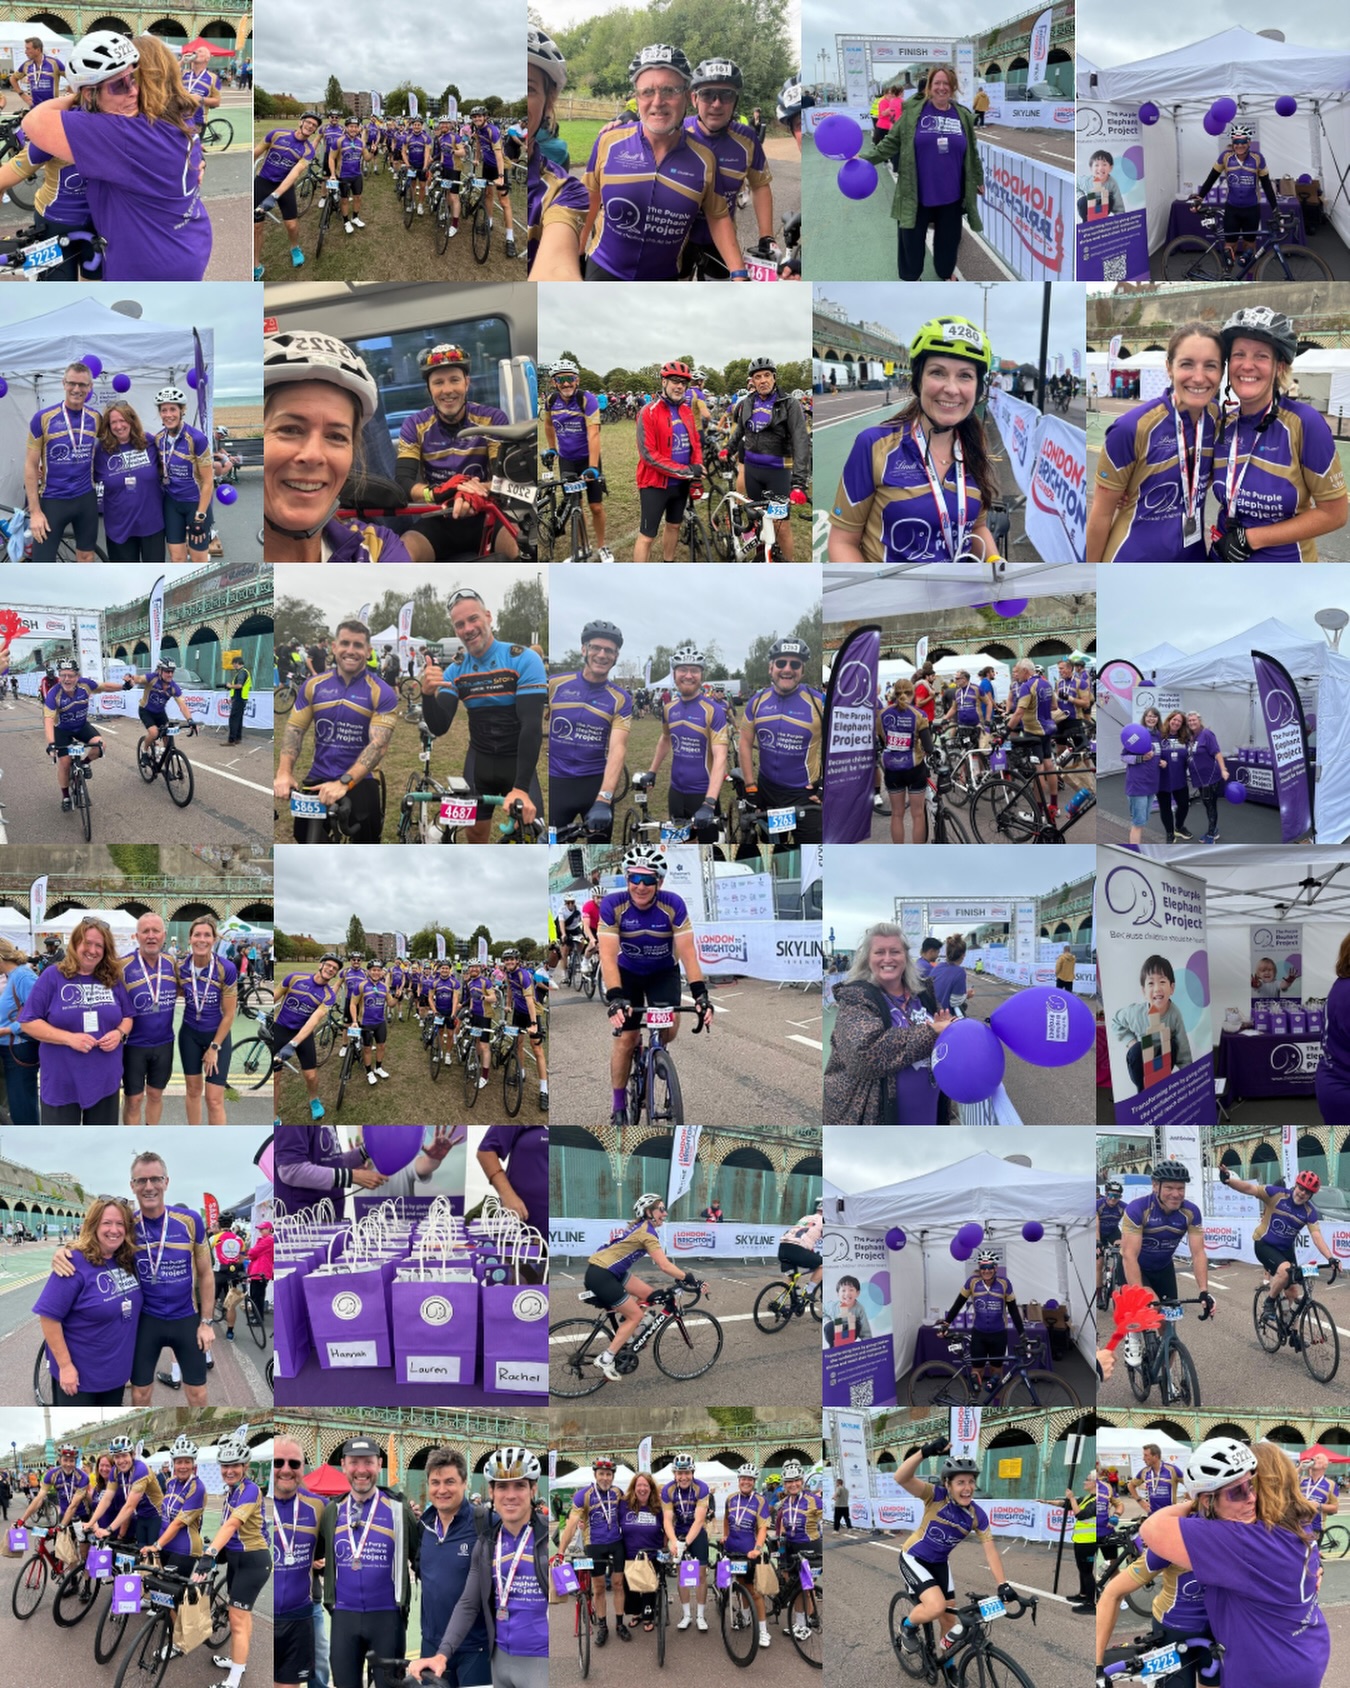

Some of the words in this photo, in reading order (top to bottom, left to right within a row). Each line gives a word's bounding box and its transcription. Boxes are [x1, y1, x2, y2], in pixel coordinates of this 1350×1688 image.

[898, 47, 929, 56] FINISH
[1012, 109, 1041, 118] SKYLINE
[1107, 118, 1139, 126] Elephant
[1108, 127, 1139, 135] Project
[647, 205, 663, 214] The
[664, 209, 691, 220] Purple
[645, 214, 688, 226] Elephant
[644, 223, 685, 236] Project
[28, 246, 58, 266] 5225
[948, 323, 980, 342] 4280
[1041, 437, 1085, 489] LONDON
[1038, 457, 1087, 534] BRIGHTON
[1252, 490, 1283, 502] Purple
[1236, 498, 1283, 511] Elephant
[834, 711, 849, 720] The
[850, 711, 872, 721] Purple
[833, 722, 872, 733] Elephant
[336, 734, 363, 744] Project
[574, 733, 603, 742] Project
[832, 733, 872, 748] Project
[776, 742, 803, 751] Project
[1277, 747, 1302, 762] Project
[828, 758, 851, 767] Because
[827, 766, 848, 775] should
[295, 801, 321, 813] 5865
[444, 806, 473, 820] 4687
[772, 815, 794, 827] 5263
[1161, 881, 1177, 895] The
[1178, 886, 1201, 901] Purple
[1163, 896, 1202, 915] Elephant
[955, 908, 986, 917] FINISH
[1164, 912, 1203, 931] Project
[699, 935, 735, 944] LONDON
[1109, 930, 1144, 940] Because
[701, 944, 742, 953] BRIGHTON
[776, 940, 823, 957] SKYLIN
[1275, 940, 1299, 948] Project
[649, 1013, 672, 1024] 4905
[1130, 1087, 1168, 1115] Transforming
[678, 1128, 687, 1162] LONDON
[549, 1231, 586, 1243] YLINE
[735, 1234, 775, 1245] SKYLINE
[854, 1243, 885, 1252] Elephant
[854, 1252, 886, 1261] Project
[160, 1268, 188, 1277] Project
[330, 1348, 367, 1359] Hannah
[409, 1361, 449, 1375] Lauren
[498, 1367, 541, 1383] Rachel
[993, 1506, 1025, 1514] LONDON
[509, 1587, 543, 1595] Project
[1146, 1652, 1176, 1672] 5225
